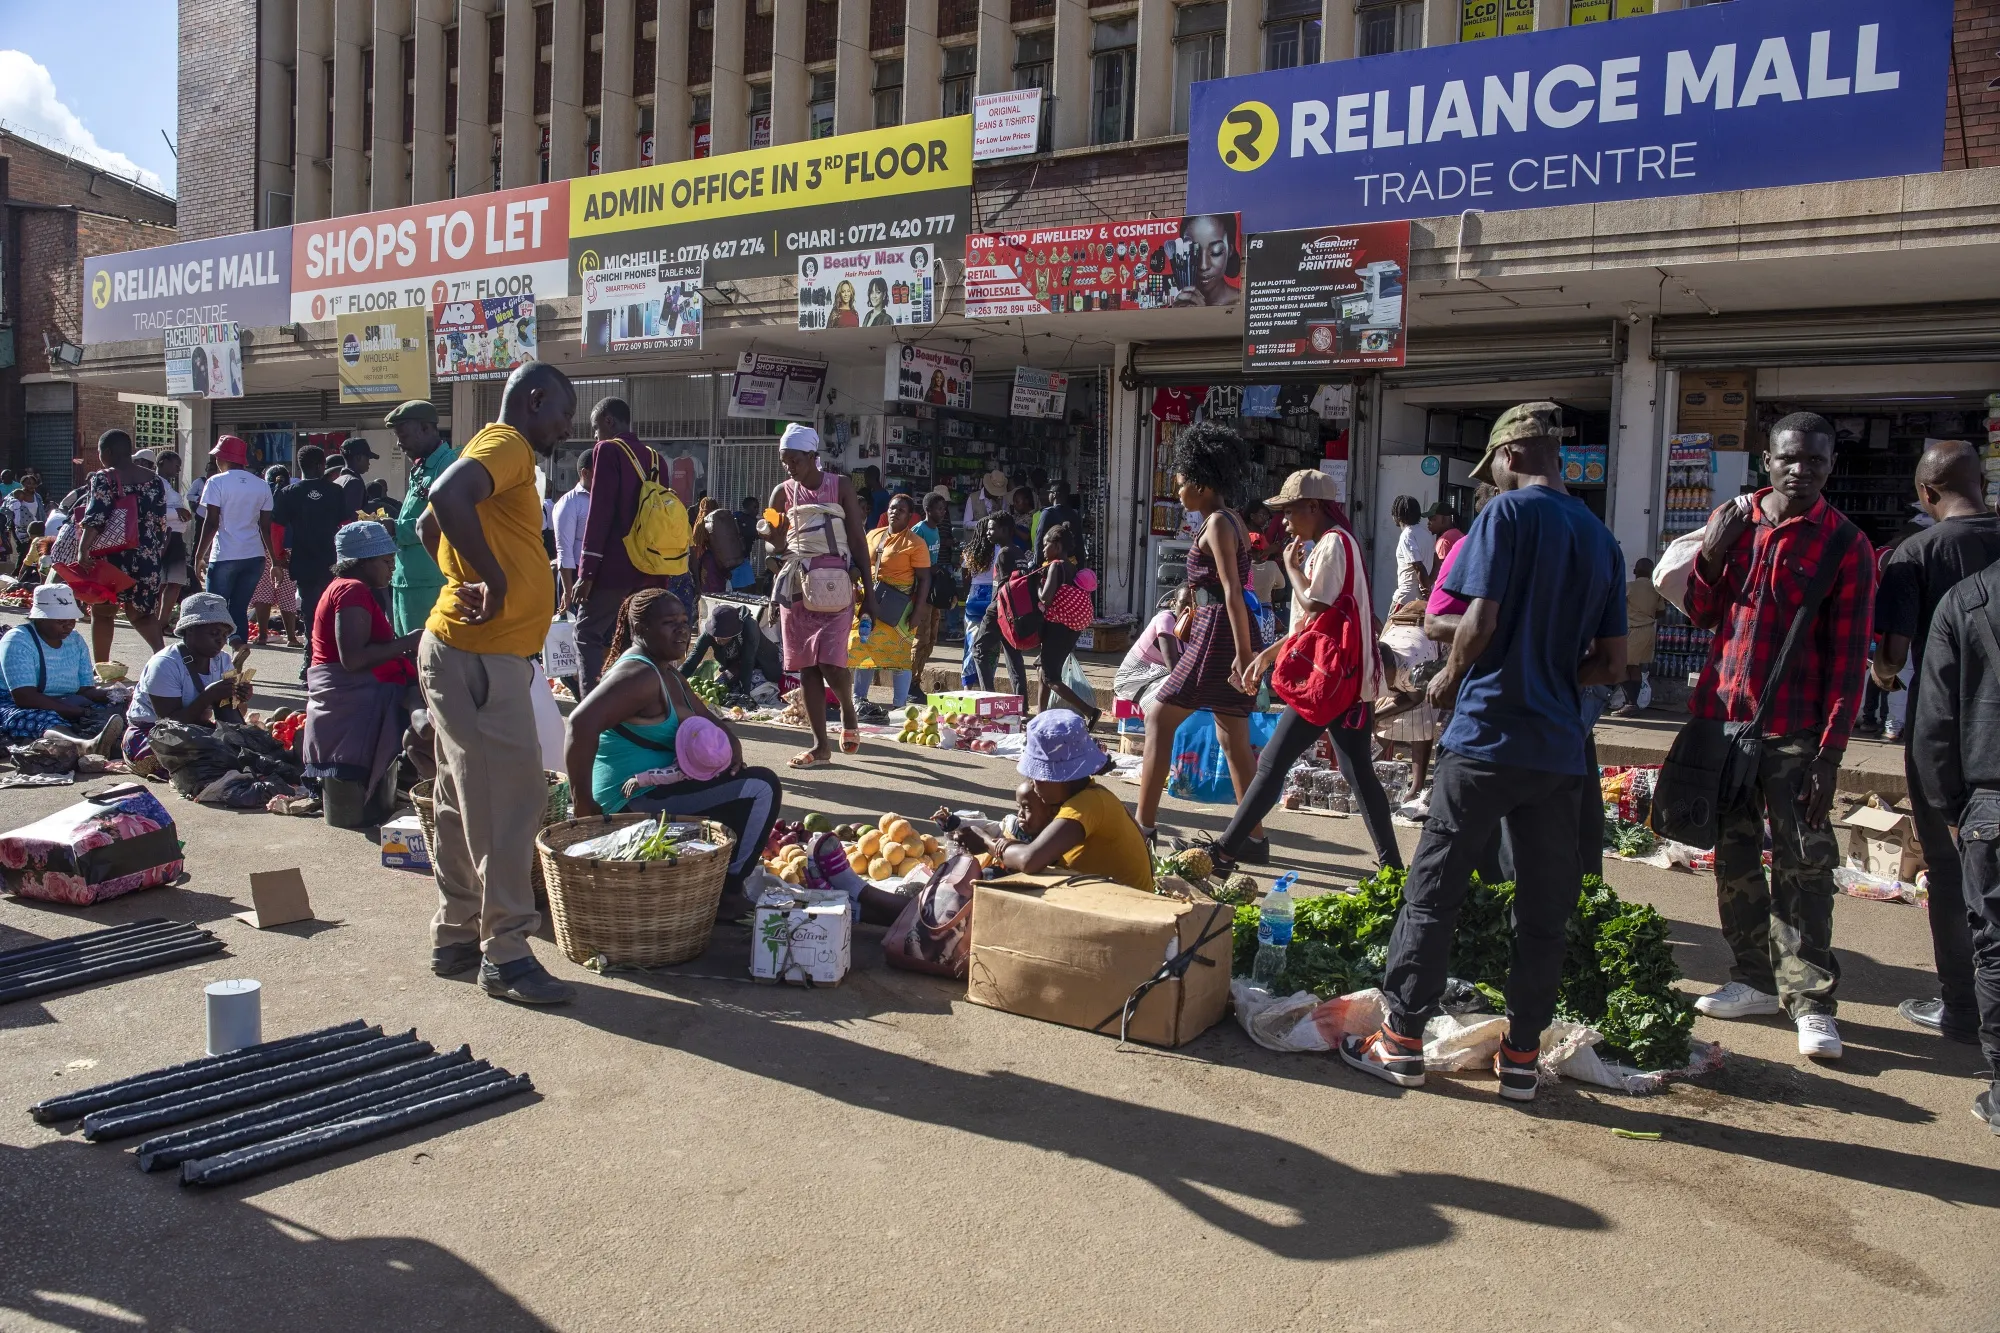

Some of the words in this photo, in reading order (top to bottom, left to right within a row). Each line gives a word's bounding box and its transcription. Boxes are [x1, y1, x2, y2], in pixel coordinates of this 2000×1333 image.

[1465, 3, 1496, 20] LCD
[1505, 9, 1534, 17] WHOLESA
[1631, 6, 1644, 14] ALL
[1464, 15, 1496, 26] WHOLESALE
[1290, 56, 1640, 159] RELIANCE
[1664, 23, 1900, 116] MALL
[988, 105, 1021, 116] ORIGINAL
[976, 120, 996, 131] JEANS
[1005, 115, 1036, 126] T/SHIRTS
[986, 136, 998, 144] Low
[999, 134, 1012, 142] Low
[584, 182, 664, 222] ADMIN
[671, 166, 765, 208] OFFICE
[771, 161, 798, 195] IN
[845, 139, 949, 184] FLOOR
[1354, 162, 1494, 206] TRADE
[1509, 142, 1697, 192] CENTRE
[306, 218, 417, 279] SHOPS
[426, 210, 475, 263] TO
[485, 197, 549, 254] LET
[786, 228, 836, 250] CHARI
[848, 222, 887, 244] 0772
[889, 218, 922, 239] 420
[925, 214, 955, 236] 777
[971, 237, 994, 249] ONE
[998, 234, 1027, 246] STOP
[1031, 228, 1093, 245] JEWELLERY
[1099, 228, 1108, 239] &
[1114, 222, 1178, 238] COSMETICS
[1250, 240, 1264, 250] F8
[604, 249, 667, 269] MICHELLE
[677, 244, 709, 262] 0776
[712, 240, 737, 259] 627
[740, 237, 765, 256] 274
[823, 253, 872, 269] Beauty
[875, 251, 905, 265] Max
[1298, 258, 1353, 271] PRINTING
[113, 259, 213, 303] RELIANCE
[218, 250, 279, 290] MALL
[595, 272, 622, 283] CHICHI
[624, 268, 657, 280] PHONES
[660, 268, 684, 278] TABLE
[858, 269, 882, 277] Products
[967, 268, 998, 280] RETAIL
[329, 295, 342, 315] 1ST
[349, 290, 397, 313] FLOOR
[405, 287, 425, 306] TO
[452, 281, 471, 302] 7TH
[476, 274, 533, 299] FLOOR
[606, 283, 646, 293] SMARTPHONES
[967, 286, 1021, 298] WHOLESALE
[1286, 284, 1333, 293] PHOTOCOPYING
[485, 309, 501, 320] Boys
[508, 295, 526, 307] Girls
[973, 306, 992, 315] +263
[995, 305, 1008, 314] 782
[1010, 304, 1025, 314] 894
[1027, 303, 1042, 313] 458
[1250, 304, 1278, 312] OUTDOOR
[1299, 301, 1328, 309] BANNERS
[133, 309, 172, 331] TRADE
[176, 304, 228, 325] CENTRE
[494, 309, 514, 323] Wear
[164, 326, 200, 348] FACEHUB
[200, 322, 239, 344] PICTURES
[614, 343, 629, 352] 0772
[630, 342, 641, 350] 609
[669, 339, 681, 348] 387
[683, 338, 693, 347] 319
[364, 352, 400, 363] WHOLESALE
[915, 349, 942, 365] Beauty
[943, 355, 959, 367] Max
[756, 362, 775, 371] SHOP
[776, 365, 788, 373] SF2
[791, 927, 828, 941] Colline
